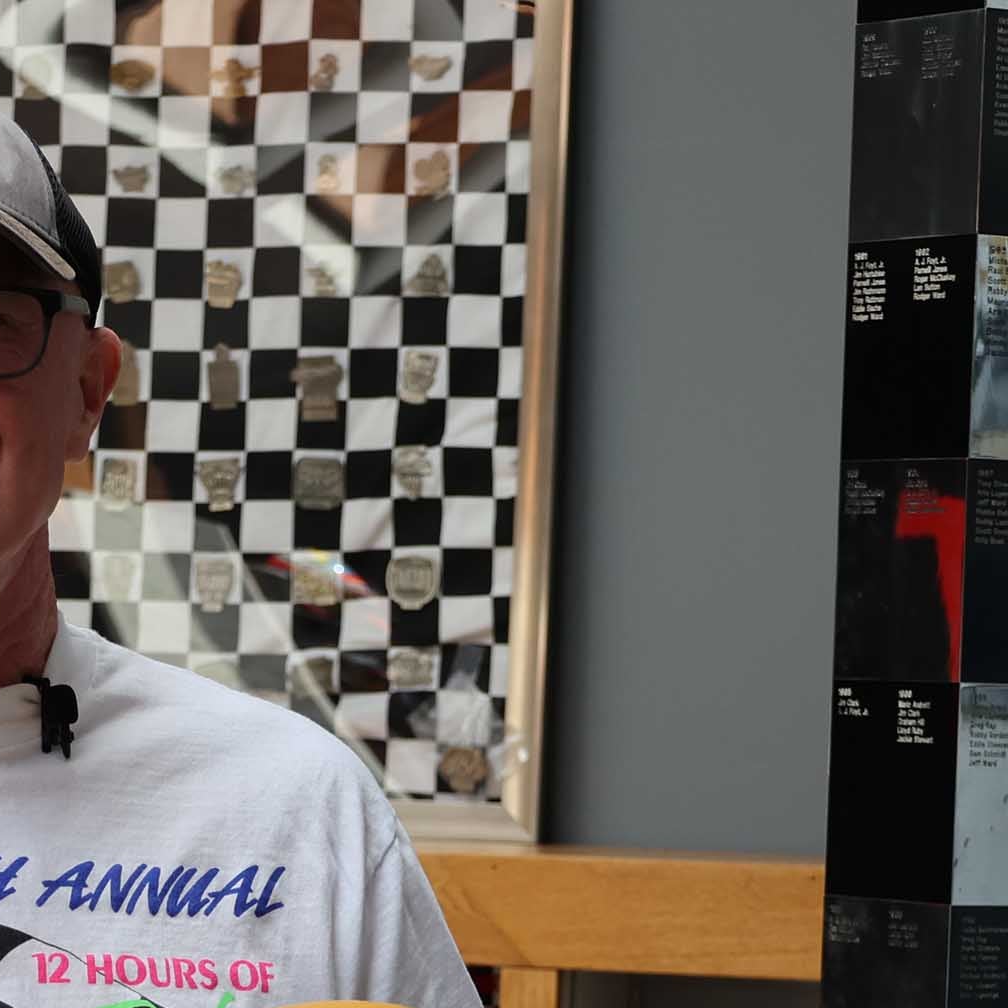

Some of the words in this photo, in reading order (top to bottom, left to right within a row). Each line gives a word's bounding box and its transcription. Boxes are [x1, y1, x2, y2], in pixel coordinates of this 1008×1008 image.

[35, 860, 286, 918] ANNUAL
[31, 952, 71, 986] 12
[85, 953, 218, 992] HOURS
[229, 959, 276, 994] OF
